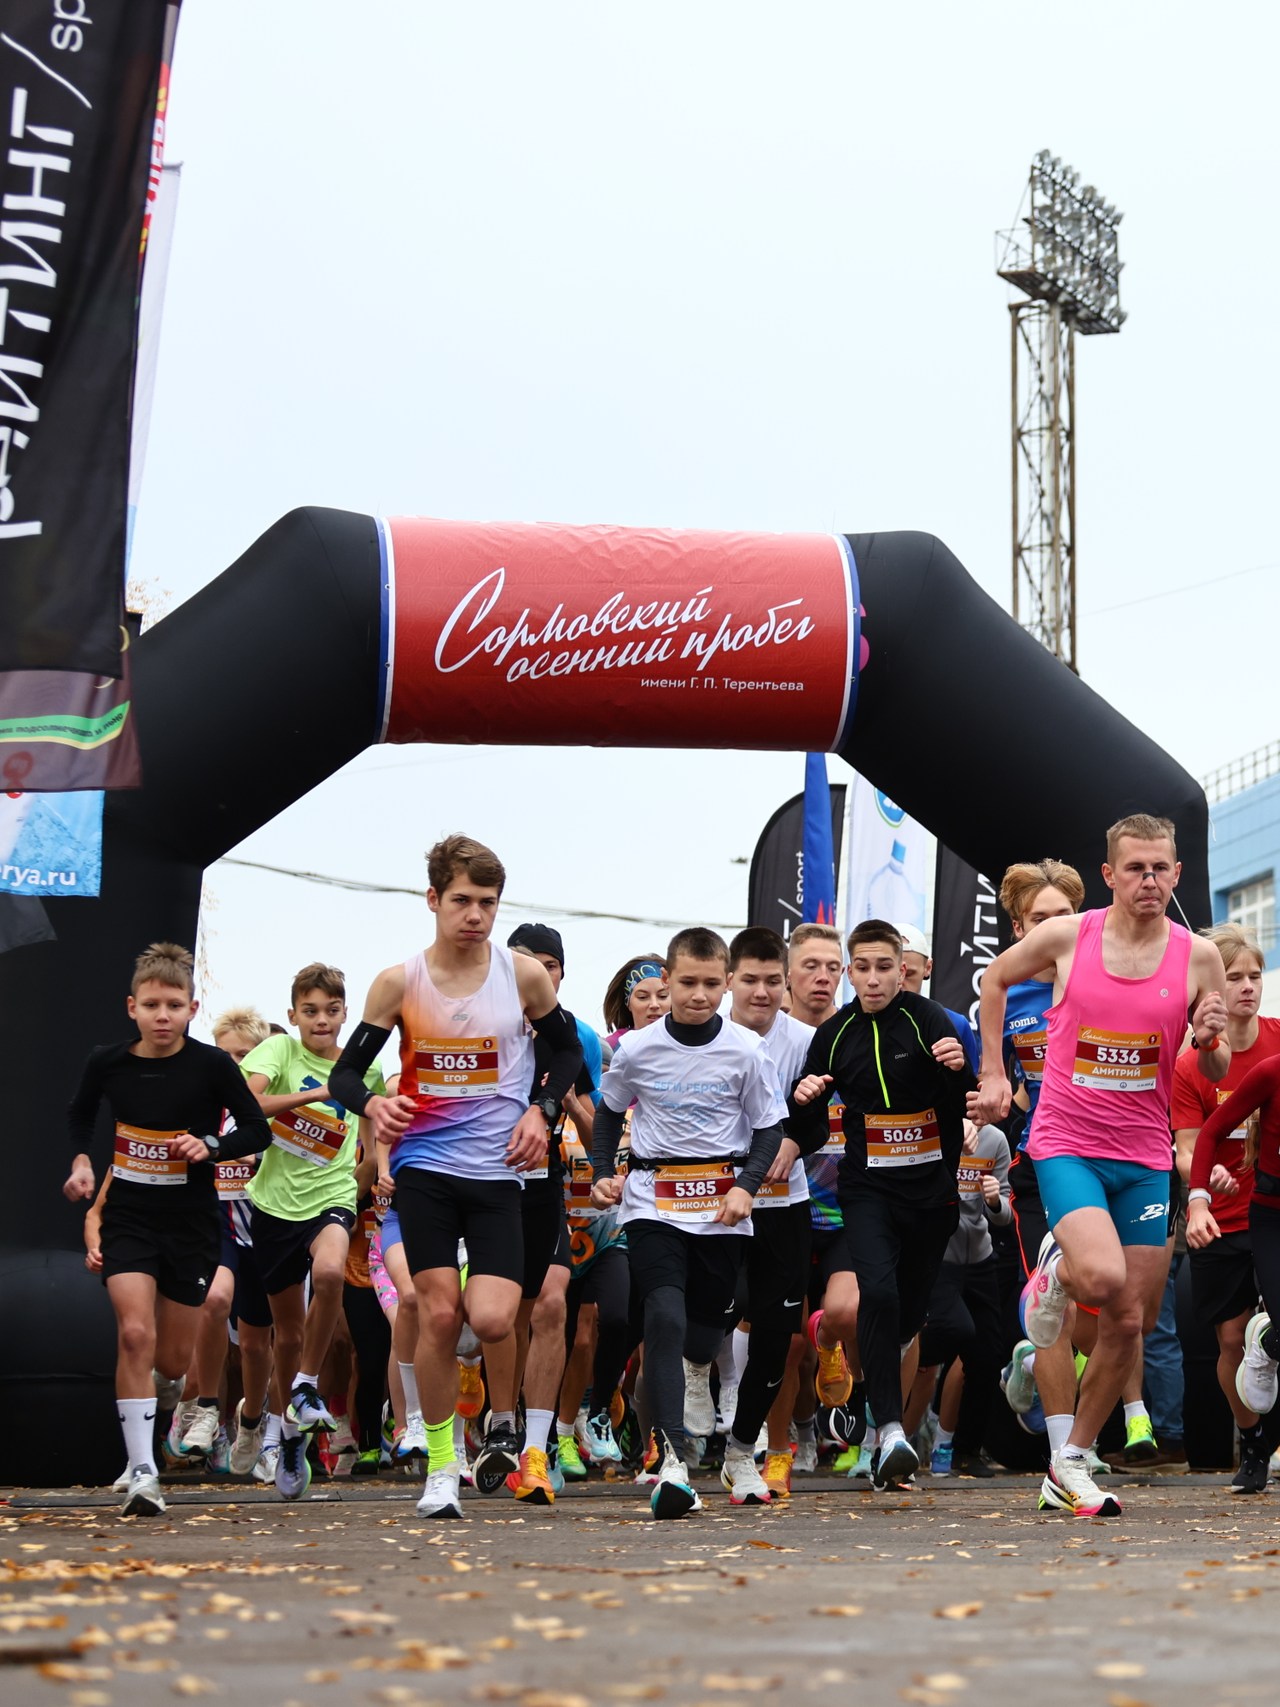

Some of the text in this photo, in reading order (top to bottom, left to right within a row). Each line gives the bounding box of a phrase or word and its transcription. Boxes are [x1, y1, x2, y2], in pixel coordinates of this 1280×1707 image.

[434, 566, 713, 673] Сормовский
[506, 598, 815, 684] осенний пробег
[640, 677, 804, 693] имени Г. П. Терентьева
[0, 864, 77, 886] rya.ru
[433, 1054, 478, 1070] 5063
[1096, 1046, 1141, 1064] 5336
[443, 1074, 468, 1083] ЕГОР
[1092, 1065, 1141, 1077] ДМИТРИЙ
[293, 1118, 327, 1142] 5101
[883, 1127, 924, 1143] 5062
[292, 1134, 315, 1149] ИЛЬЯ
[889, 1145, 918, 1154] АРТЕМ
[128, 1141, 169, 1160] 5065
[126, 1160, 169, 1172] ЯРОСЛАВ
[218, 1166, 251, 1179] 5042
[675, 1181, 717, 1197] 5385
[672, 1198, 720, 1210] НИКОЛАЙ
